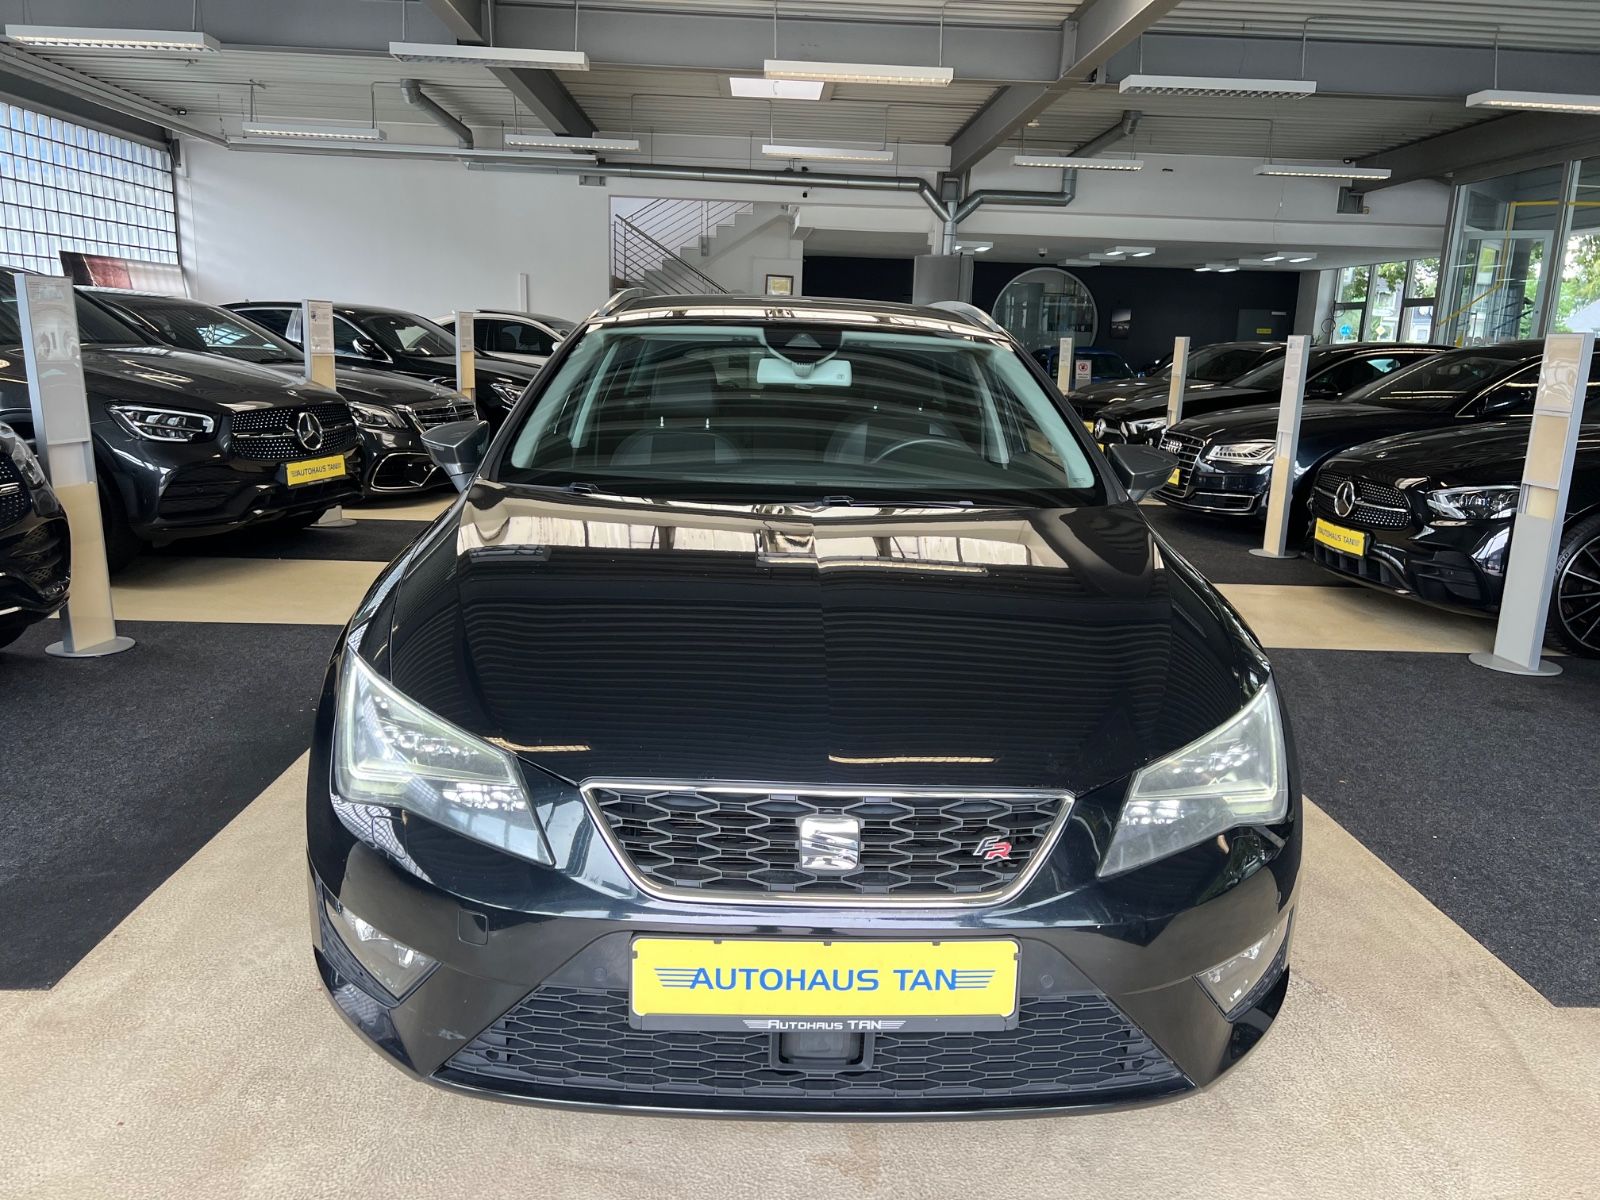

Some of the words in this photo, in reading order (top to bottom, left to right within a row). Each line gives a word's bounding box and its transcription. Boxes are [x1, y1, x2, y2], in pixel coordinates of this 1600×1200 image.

[296, 465, 326, 476] AUTOHAUS
[973, 835, 1012, 860] FR
[689, 967, 879, 992] AUTOHAUS
[893, 968, 956, 992] TAN
[767, 1019, 844, 1031] AUTOHAUS
[847, 1019, 882, 1031] TAN
